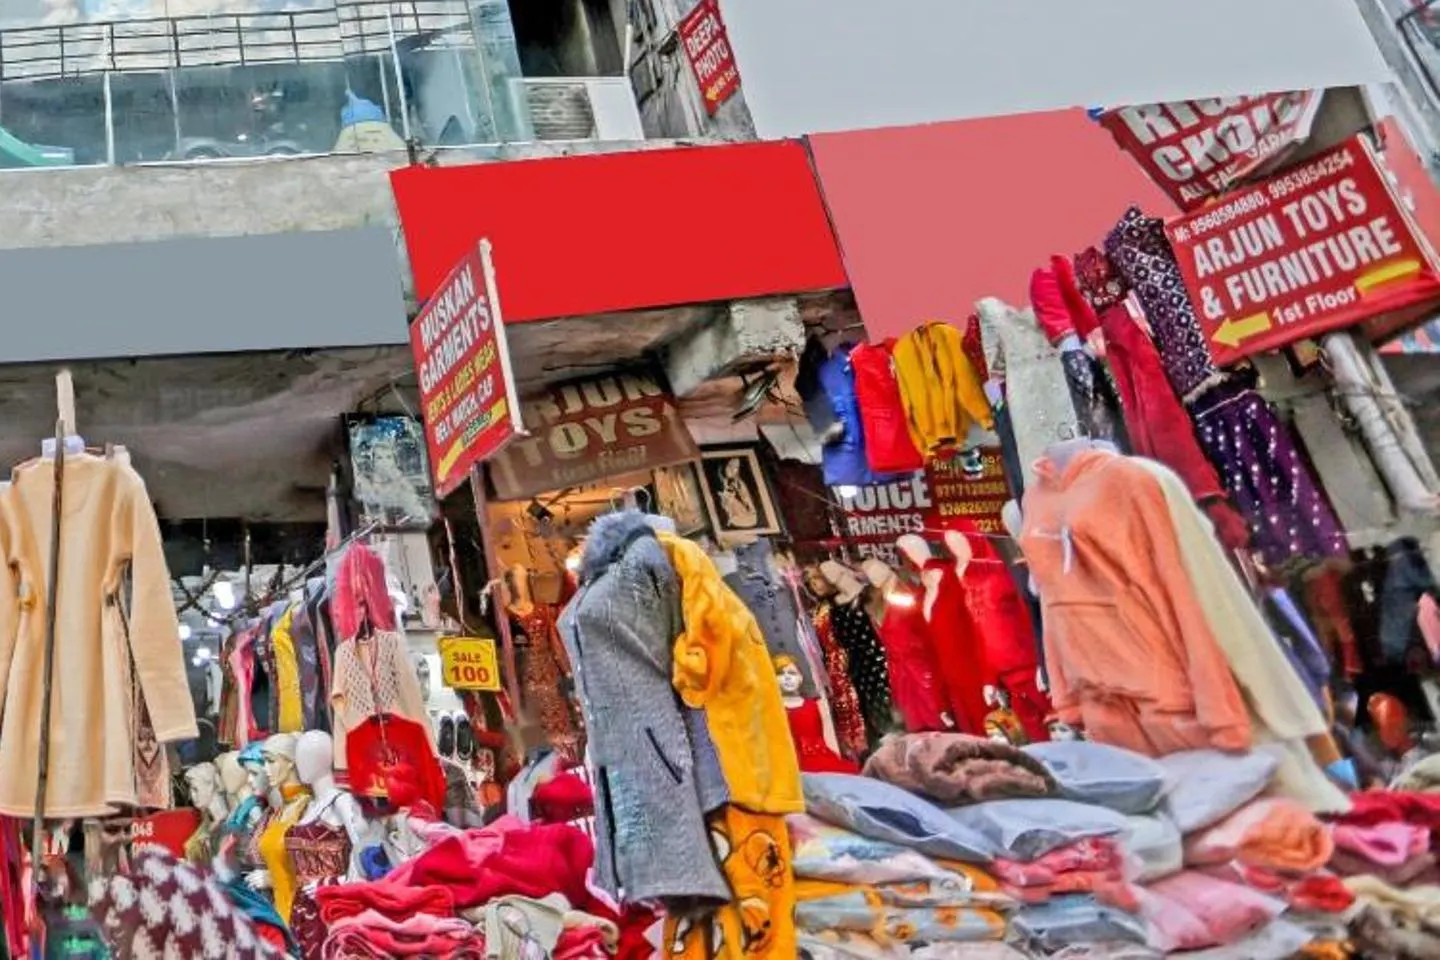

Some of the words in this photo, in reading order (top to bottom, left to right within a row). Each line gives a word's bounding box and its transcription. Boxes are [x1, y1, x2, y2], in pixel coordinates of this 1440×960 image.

[1192, 215, 1285, 280] ARJUN
[1282, 178, 1368, 239] TOYS
[1199, 285, 1226, 320] &
[1224, 217, 1402, 311] FURNITURE
[1273, 307, 1302, 326] 1st
[1305, 285, 1356, 312] Floor
[419, 263, 475, 351] MUSKAN
[419, 295, 491, 394] GARMENTS
[513, 406, 661, 466] TOYS
[451, 665, 490, 684] 100
[452, 651, 482, 664] SALE
